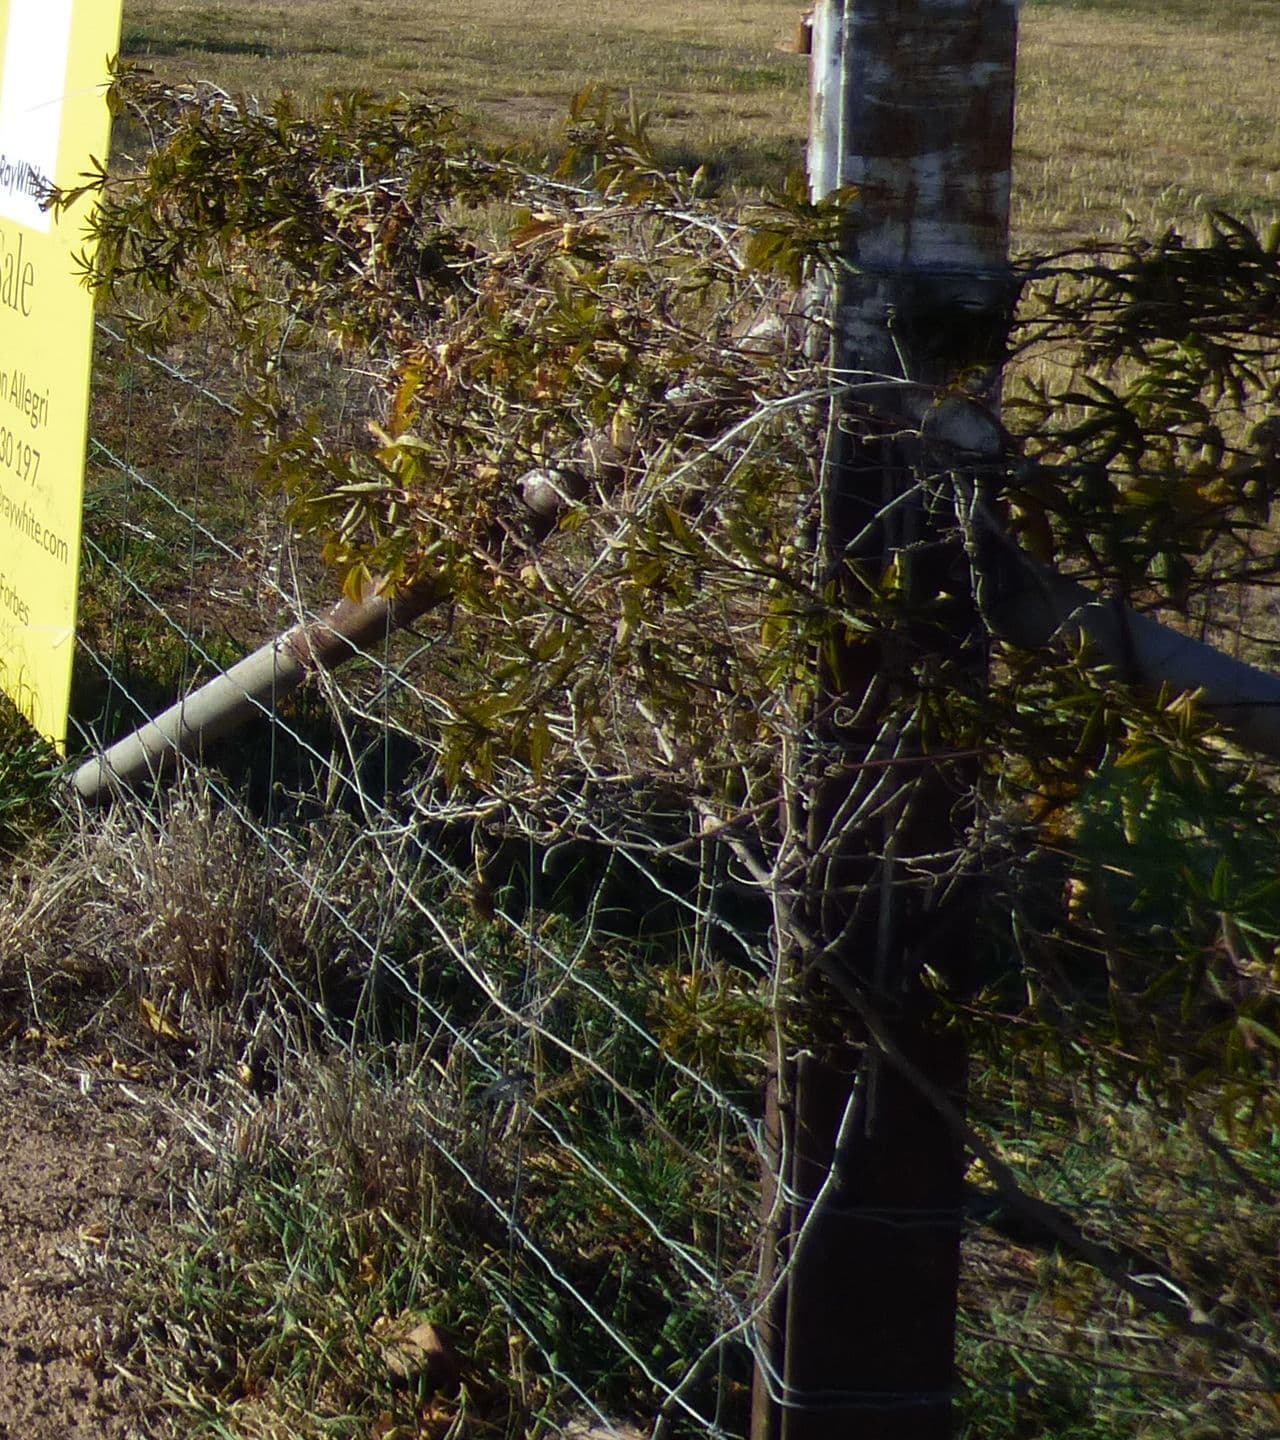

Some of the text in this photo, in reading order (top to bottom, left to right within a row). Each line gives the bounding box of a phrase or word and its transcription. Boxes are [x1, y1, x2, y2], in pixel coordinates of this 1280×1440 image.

[9, 369, 49, 428] Allegri
[15, 440, 40, 487] 197
[0, 573, 30, 625] Forbes
